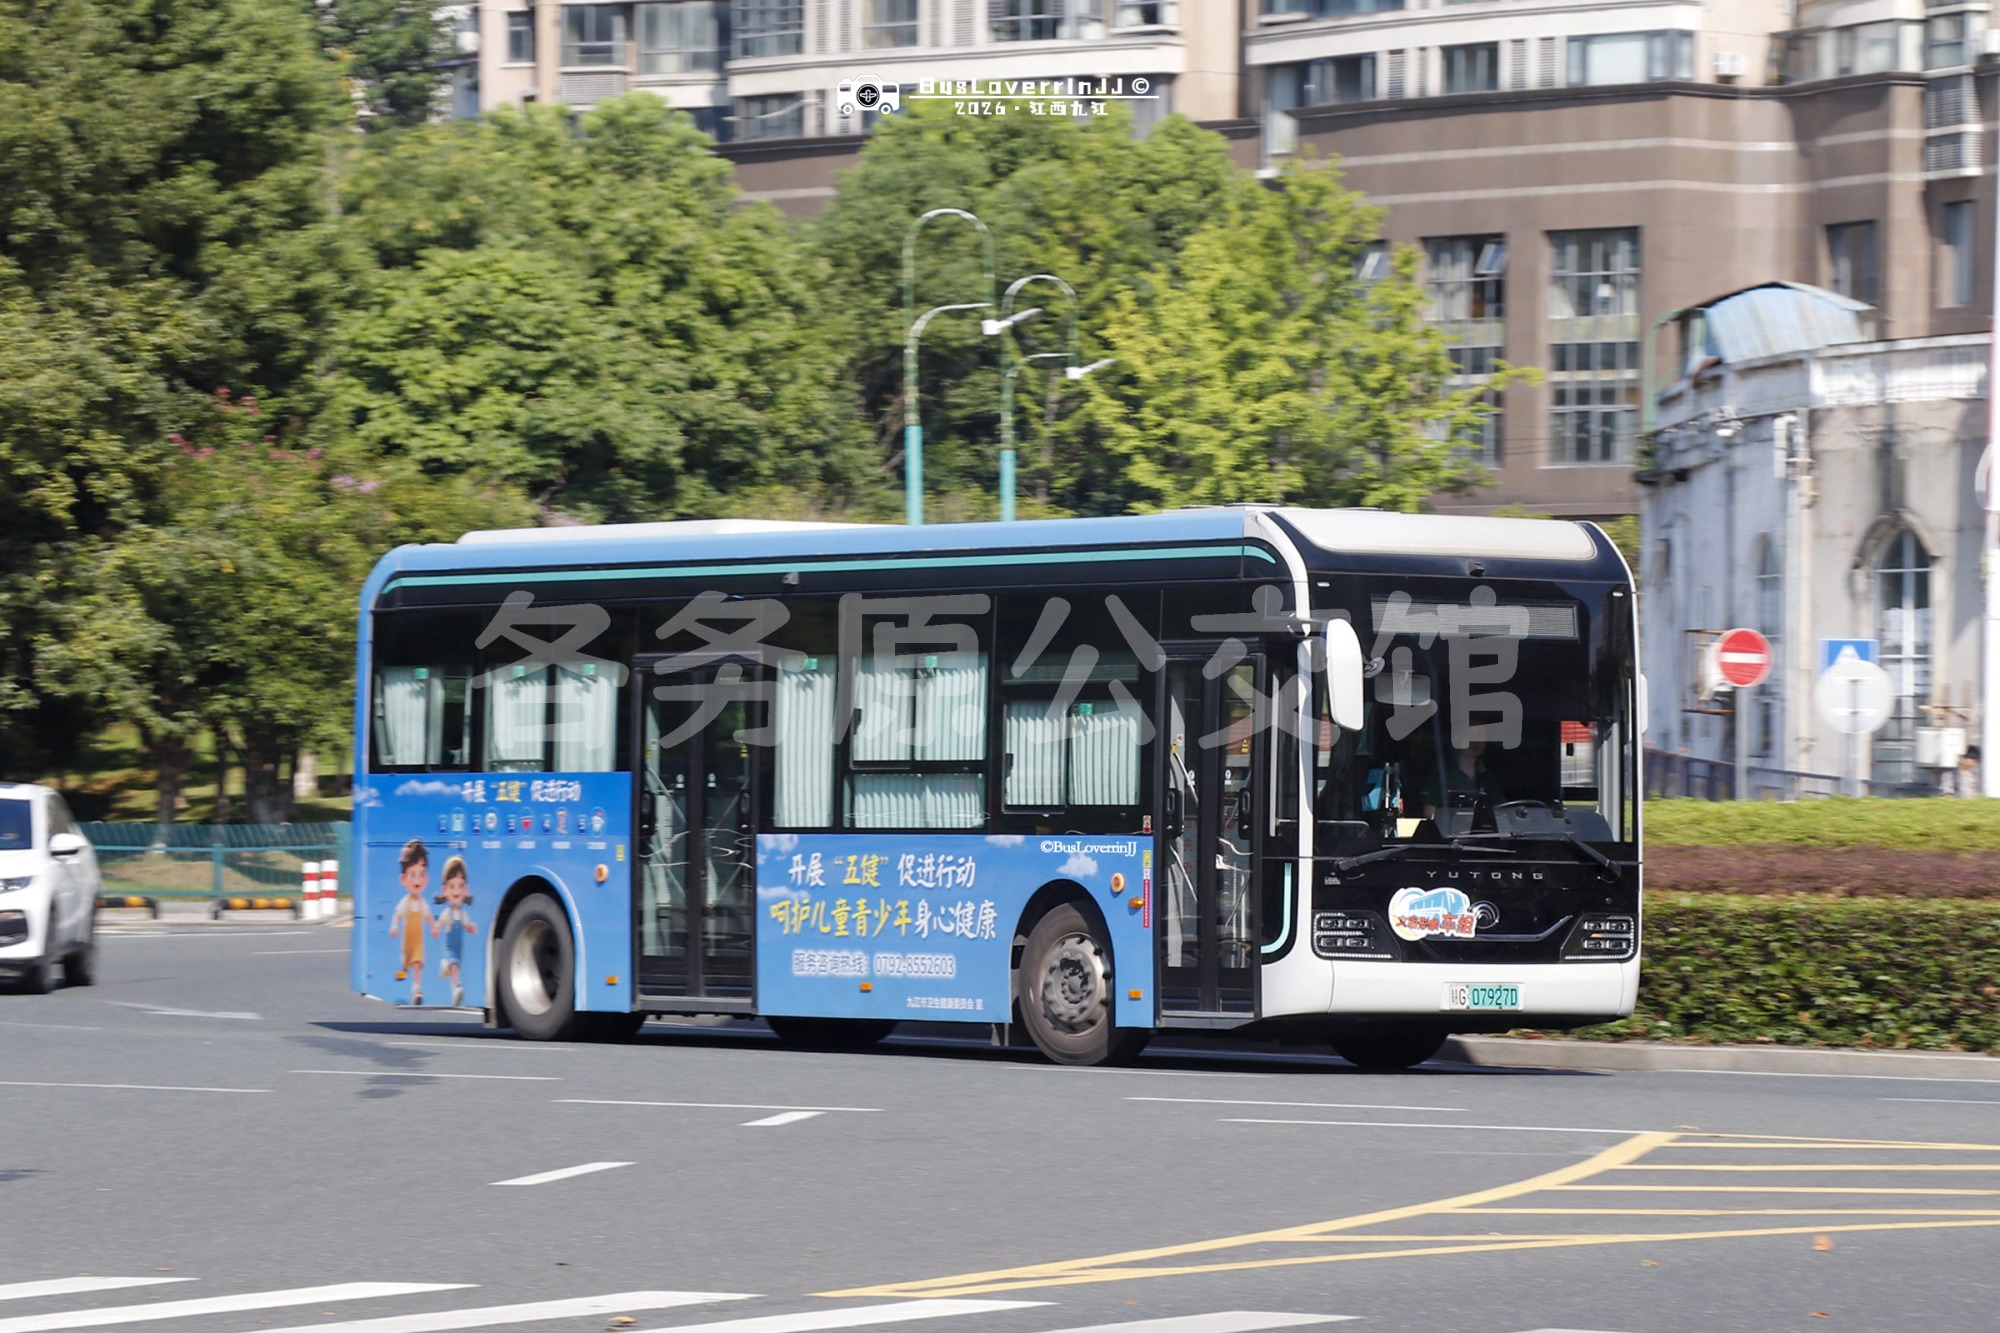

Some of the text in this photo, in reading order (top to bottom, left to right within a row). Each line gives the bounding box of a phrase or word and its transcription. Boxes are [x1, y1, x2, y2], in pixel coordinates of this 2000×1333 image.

[1426, 870, 1544, 881] YUTONG
[769, 898, 998, 940] 呵护儿童青少年身心健康
[876, 954, 955, 976] 0792-8552603
